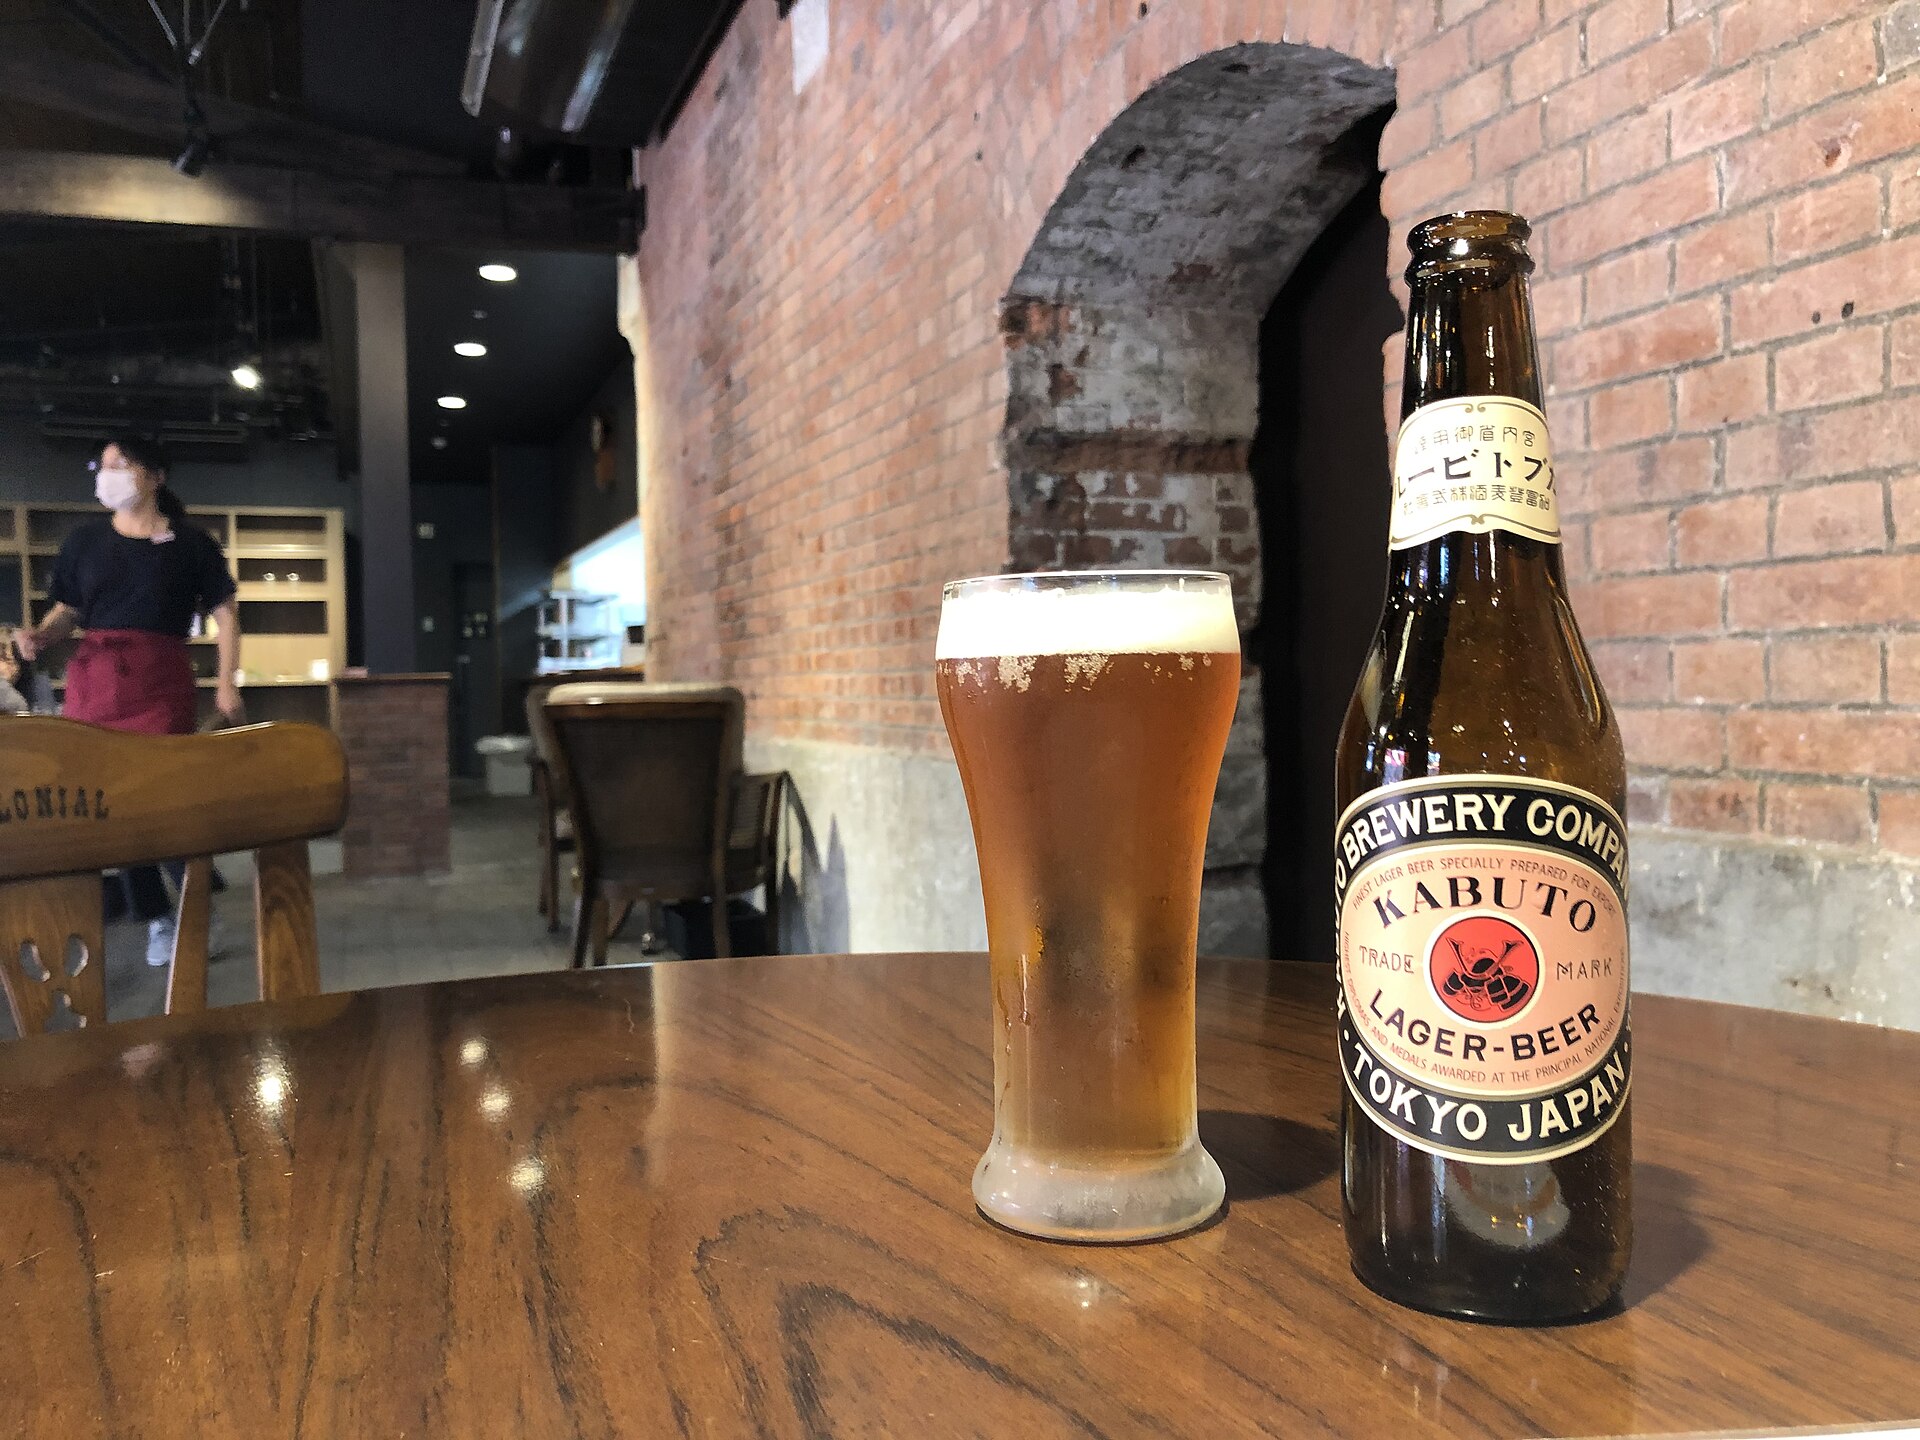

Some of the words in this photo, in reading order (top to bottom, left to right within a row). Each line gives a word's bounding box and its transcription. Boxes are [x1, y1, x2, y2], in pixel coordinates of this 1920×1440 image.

[1341, 796, 1517, 869] BREWERY
[1352, 881, 1373, 910] FINEST
[1374, 866, 1404, 887] LAGER
[1407, 860, 1435, 875] BEER
[1440, 857, 1504, 869] SPECIALLY
[1511, 860, 1568, 881] PREPARED
[1571, 874, 1591, 892] FOR
[1373, 876, 1596, 932] KABUTO
[1359, 945, 1415, 974] TRADE
[1557, 957, 1612, 980] MARK
[1371, 1026, 1388, 1046] AND
[1391, 1043, 1428, 1069] MEDALS
[1432, 1063, 1486, 1083] AWARDED
[1492, 1073, 1505, 1083] AT
[1511, 1071, 1532, 1081] THE
[1535, 1053, 1581, 1078] PRINCIPAL
[1584, 1018, 1615, 1056] NATIONAL
[1352, 1042, 1487, 1141] TOKYO
[1508, 1049, 1625, 1142] JAPAN
